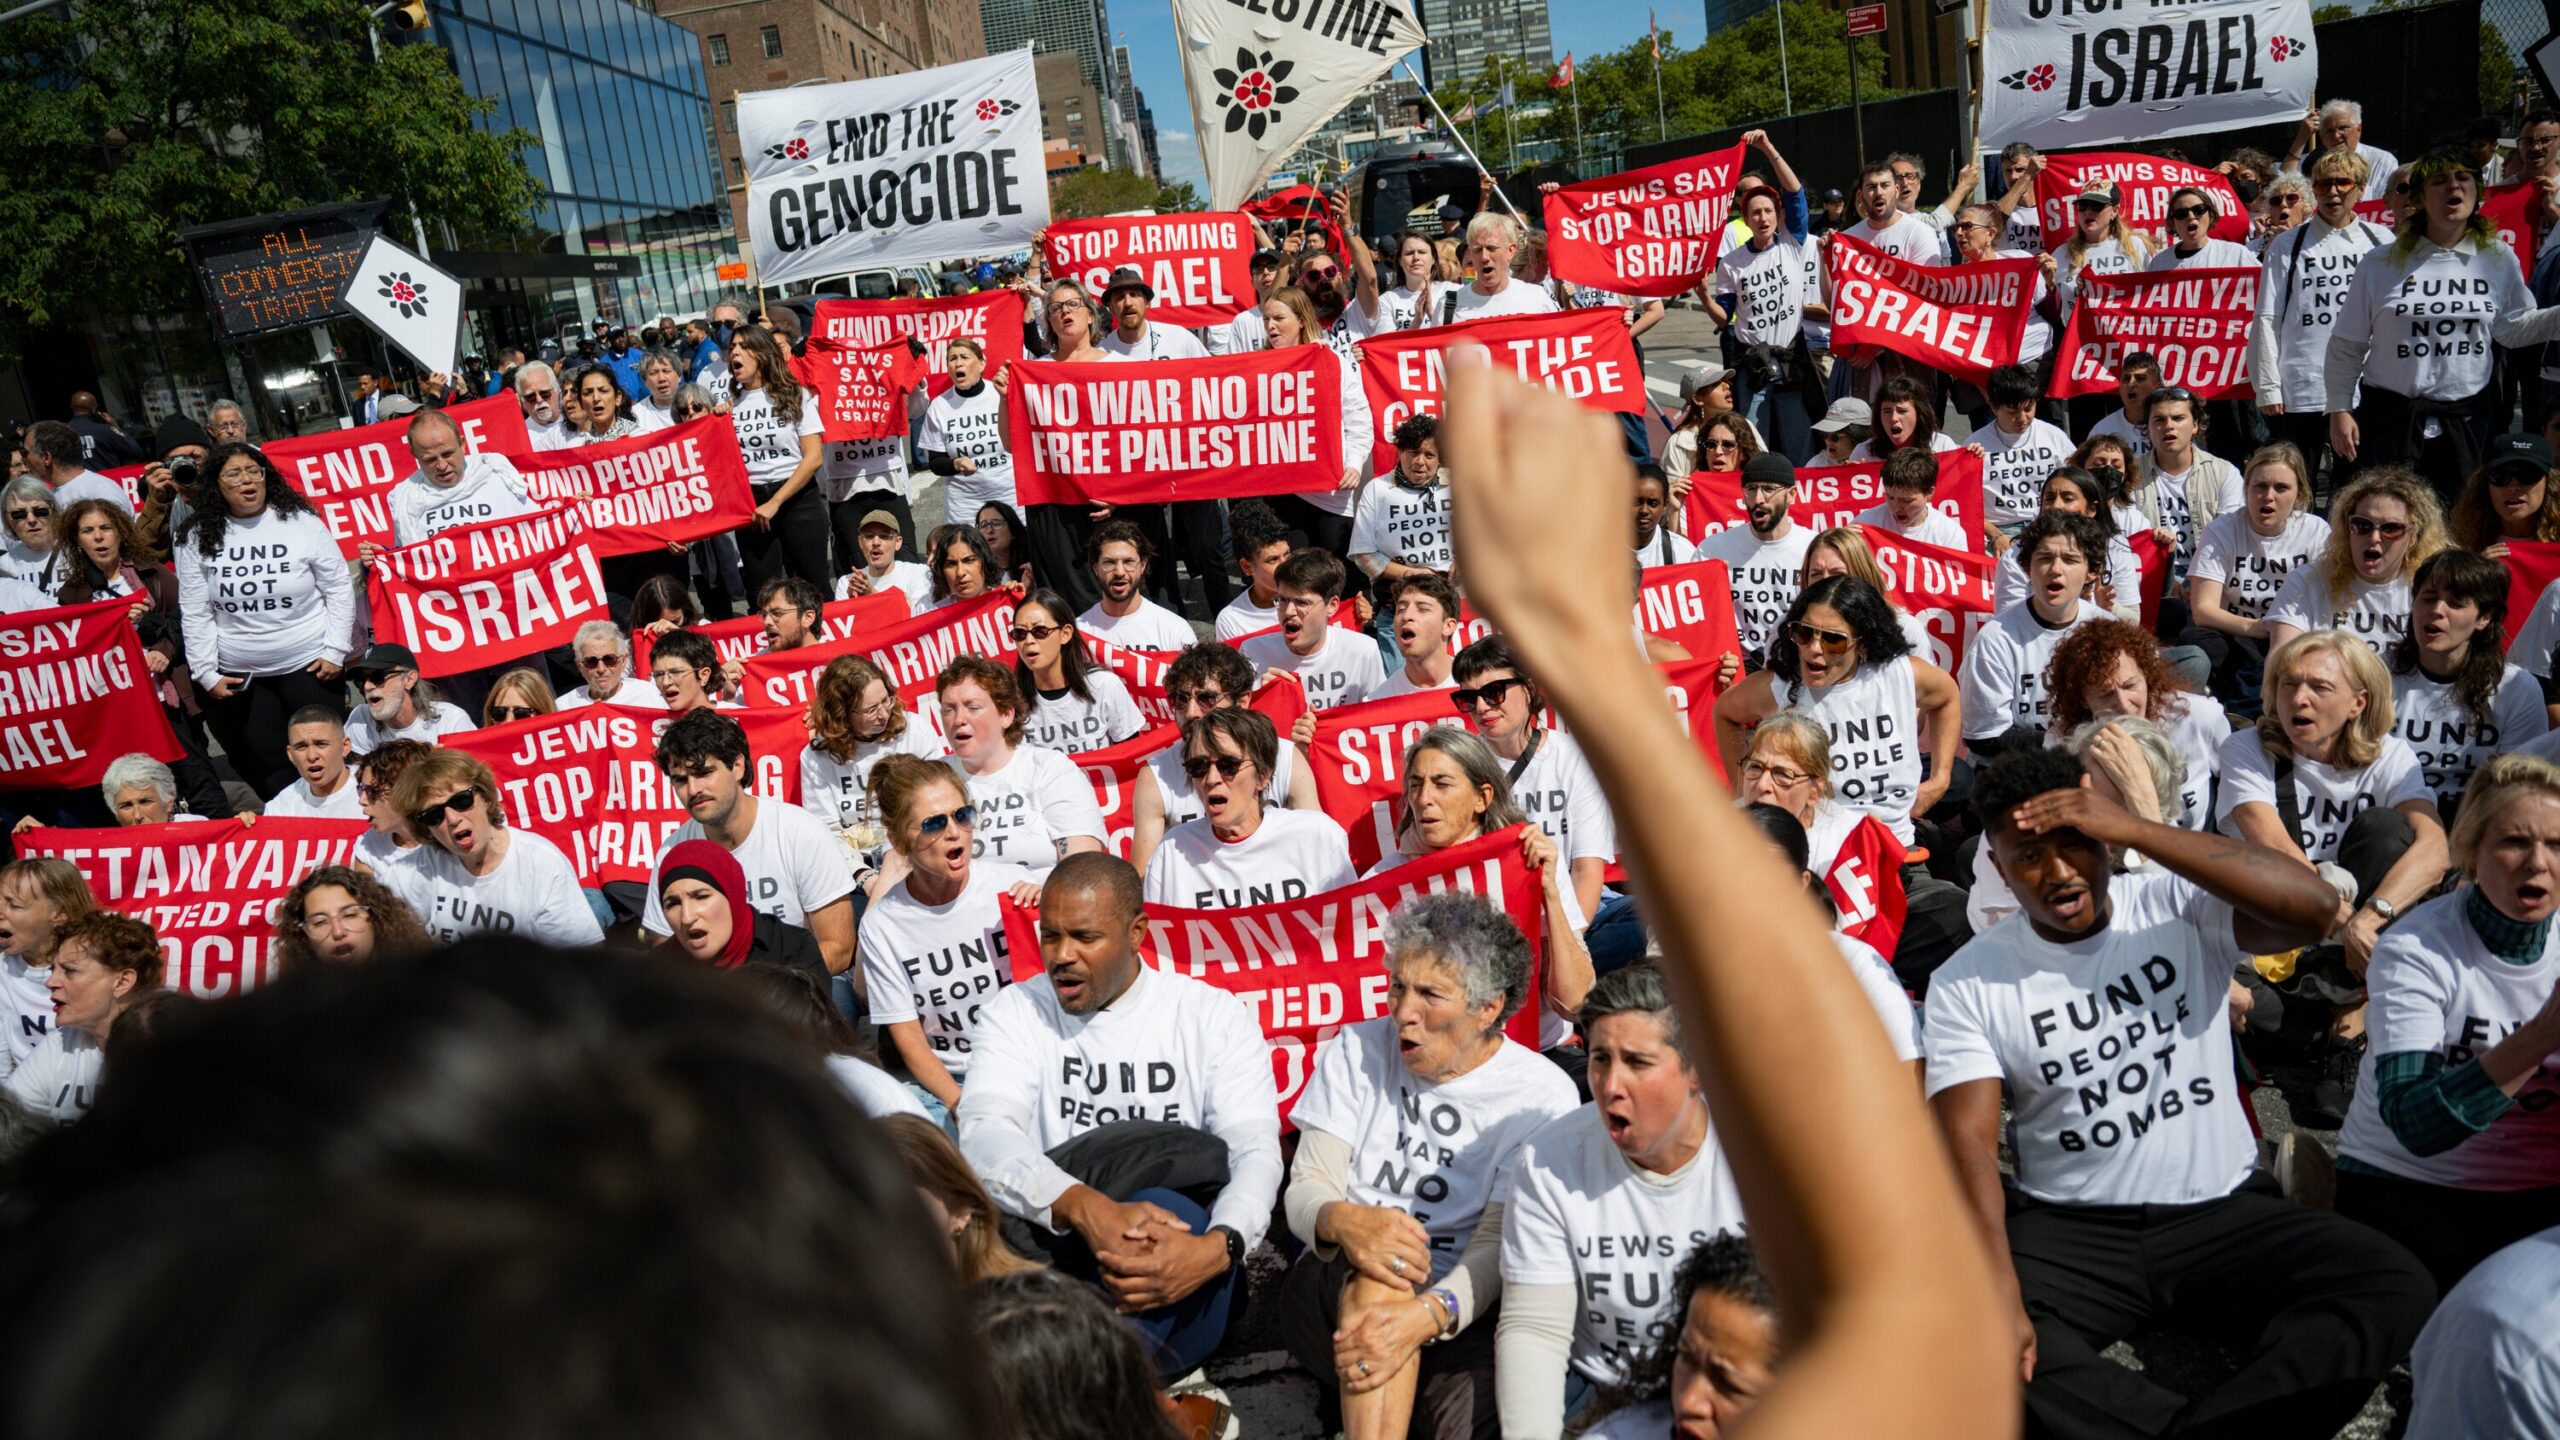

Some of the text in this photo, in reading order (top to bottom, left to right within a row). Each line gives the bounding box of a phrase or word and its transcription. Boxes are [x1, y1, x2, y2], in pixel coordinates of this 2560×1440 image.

[2066, 14, 2264, 111] ISRAEL
[827, 99, 958, 165] END THE
[1580, 164, 1730, 212] JEWS SAY
[2069, 162, 2155, 187] JEWS
[769, 148, 1022, 252] GENOCIDE
[2045, 187, 2238, 232] ST ARNG
[1561, 189, 1736, 246] STOP ARMI
[2359, 209, 2395, 229] WS
[262, 228, 322, 257] ALL
[1054, 222, 1238, 266] STOP ARMING
[1878, 244, 1899, 257] ND
[220, 249, 361, 297] COMMERCI
[1615, 241, 1709, 278] ISRAEL
[2091, 255, 2125, 269] ND
[2304, 254, 2358, 273] FUN
[1070, 257, 1234, 308] SAEL
[1832, 242, 1895, 280] STOP
[1900, 264, 2020, 307] ARMING
[2302, 274, 2354, 289] PEOP
[2401, 278, 2490, 298] FUND
[241, 285, 336, 324] TRAFF
[2084, 275, 2255, 311] NETANYA
[2315, 291, 2347, 307] NO
[1747, 304, 1796, 331] BOMBS
[2395, 300, 2495, 317] PEOPLE
[828, 305, 989, 347] FUND PEOPLE
[1831, 279, 1994, 368] ISRAEL
[2094, 315, 2217, 339] WANTED
[2411, 318, 2480, 337] NOT
[832, 352, 893, 368] JEWS
[2397, 340, 2484, 359] BOMBS
[840, 368, 885, 382] SAY
[2071, 342, 2251, 388] GEOCI
[710, 380, 728, 390] FU
[838, 384, 887, 398] STOP
[1023, 370, 1316, 427] NO WAR NO ICE
[835, 399, 891, 411] ARMING
[835, 411, 887, 424] ISRAEL
[734, 419, 786, 434] EOPLE
[948, 429, 998, 443] PEOPL
[742, 448, 791, 465] OMBS
[835, 444, 896, 462] BOMBS
[956, 441, 999, 458] NOT
[975, 454, 1008, 468] MBS
[1031, 419, 1317, 475] FREE PALESTINE
[1990, 447, 2052, 466] FUND
[296, 442, 395, 497] END
[593, 437, 705, 494] PEOPLE
[1990, 463, 2053, 480] PEOPLE
[2001, 479, 2045, 496] NOT
[425, 503, 492, 525] FUND
[592, 476, 713, 529] BOMBS
[1995, 496, 2042, 509] BOM
[1388, 515, 1448, 533] PEOPL
[2160, 516, 2191, 527] EOP
[211, 544, 288, 562] FUND
[374, 500, 596, 583] STOP ARMIN
[1401, 529, 1450, 551] NOT
[210, 562, 291, 578] PEOPLE
[1395, 548, 1450, 565] BOMB
[1876, 546, 1967, 596] STOP
[2229, 577, 2285, 592] PEOP
[219, 579, 277, 598] NOT
[1731, 590, 1793, 604] PEOPL
[214, 597, 294, 613] BOMBS
[1743, 608, 1787, 625] NO
[822, 614, 855, 643] AY
[2332, 612, 2402, 633] FUN
[1, 618, 82, 658] SAY
[766, 663, 827, 706] ST
[869, 605, 1017, 689] ARMING
[0, 645, 134, 717] RMING
[1308, 670, 1346, 692] ND
[512, 717, 638, 767] JEWS
[1026, 715, 1100, 743] FUND
[1828, 715, 1894, 746] UND
[2391, 718, 2500, 748] UND
[0, 718, 87, 772] AEL
[1831, 743, 1904, 772] OPLE
[2418, 751, 2476, 770] OPL
[497, 755, 784, 830] TOP ARG
[841, 775, 868, 795] FU
[1842, 773, 1890, 799] OT
[2424, 772, 2470, 789] OT
[980, 793, 1024, 813] ND
[1515, 789, 1566, 812] ND
[2300, 792, 2376, 824] UN
[980, 815, 1026, 832] PLE
[572, 820, 681, 880] ISRA
[971, 835, 1009, 858] OT
[24, 838, 358, 900] TANYAH
[1194, 877, 1307, 910] FUND
[140, 898, 286, 932] TED FO
[1146, 858, 1505, 978] TANYA
[913, 969, 1014, 1009] EOPL
[2031, 955, 2177, 1048] FUND
[1236, 982, 1344, 1030] TED
[2040, 993, 2190, 1085] PEOPLE
[1063, 1055, 1176, 1096] FUND
[2078, 1043, 2176, 1117] NOT
[1060, 1096, 1181, 1127] PEOE
[1401, 1086, 1462, 1137] NO
[2059, 1076, 2215, 1152] BOMBS
[1396, 1131, 1455, 1168] WAR
[1373, 1160, 1449, 1203] NO
[1576, 1235, 1675, 1258] JEWS
[1585, 1272, 1660, 1309] FU
[1588, 1311, 1676, 1340] PEO
